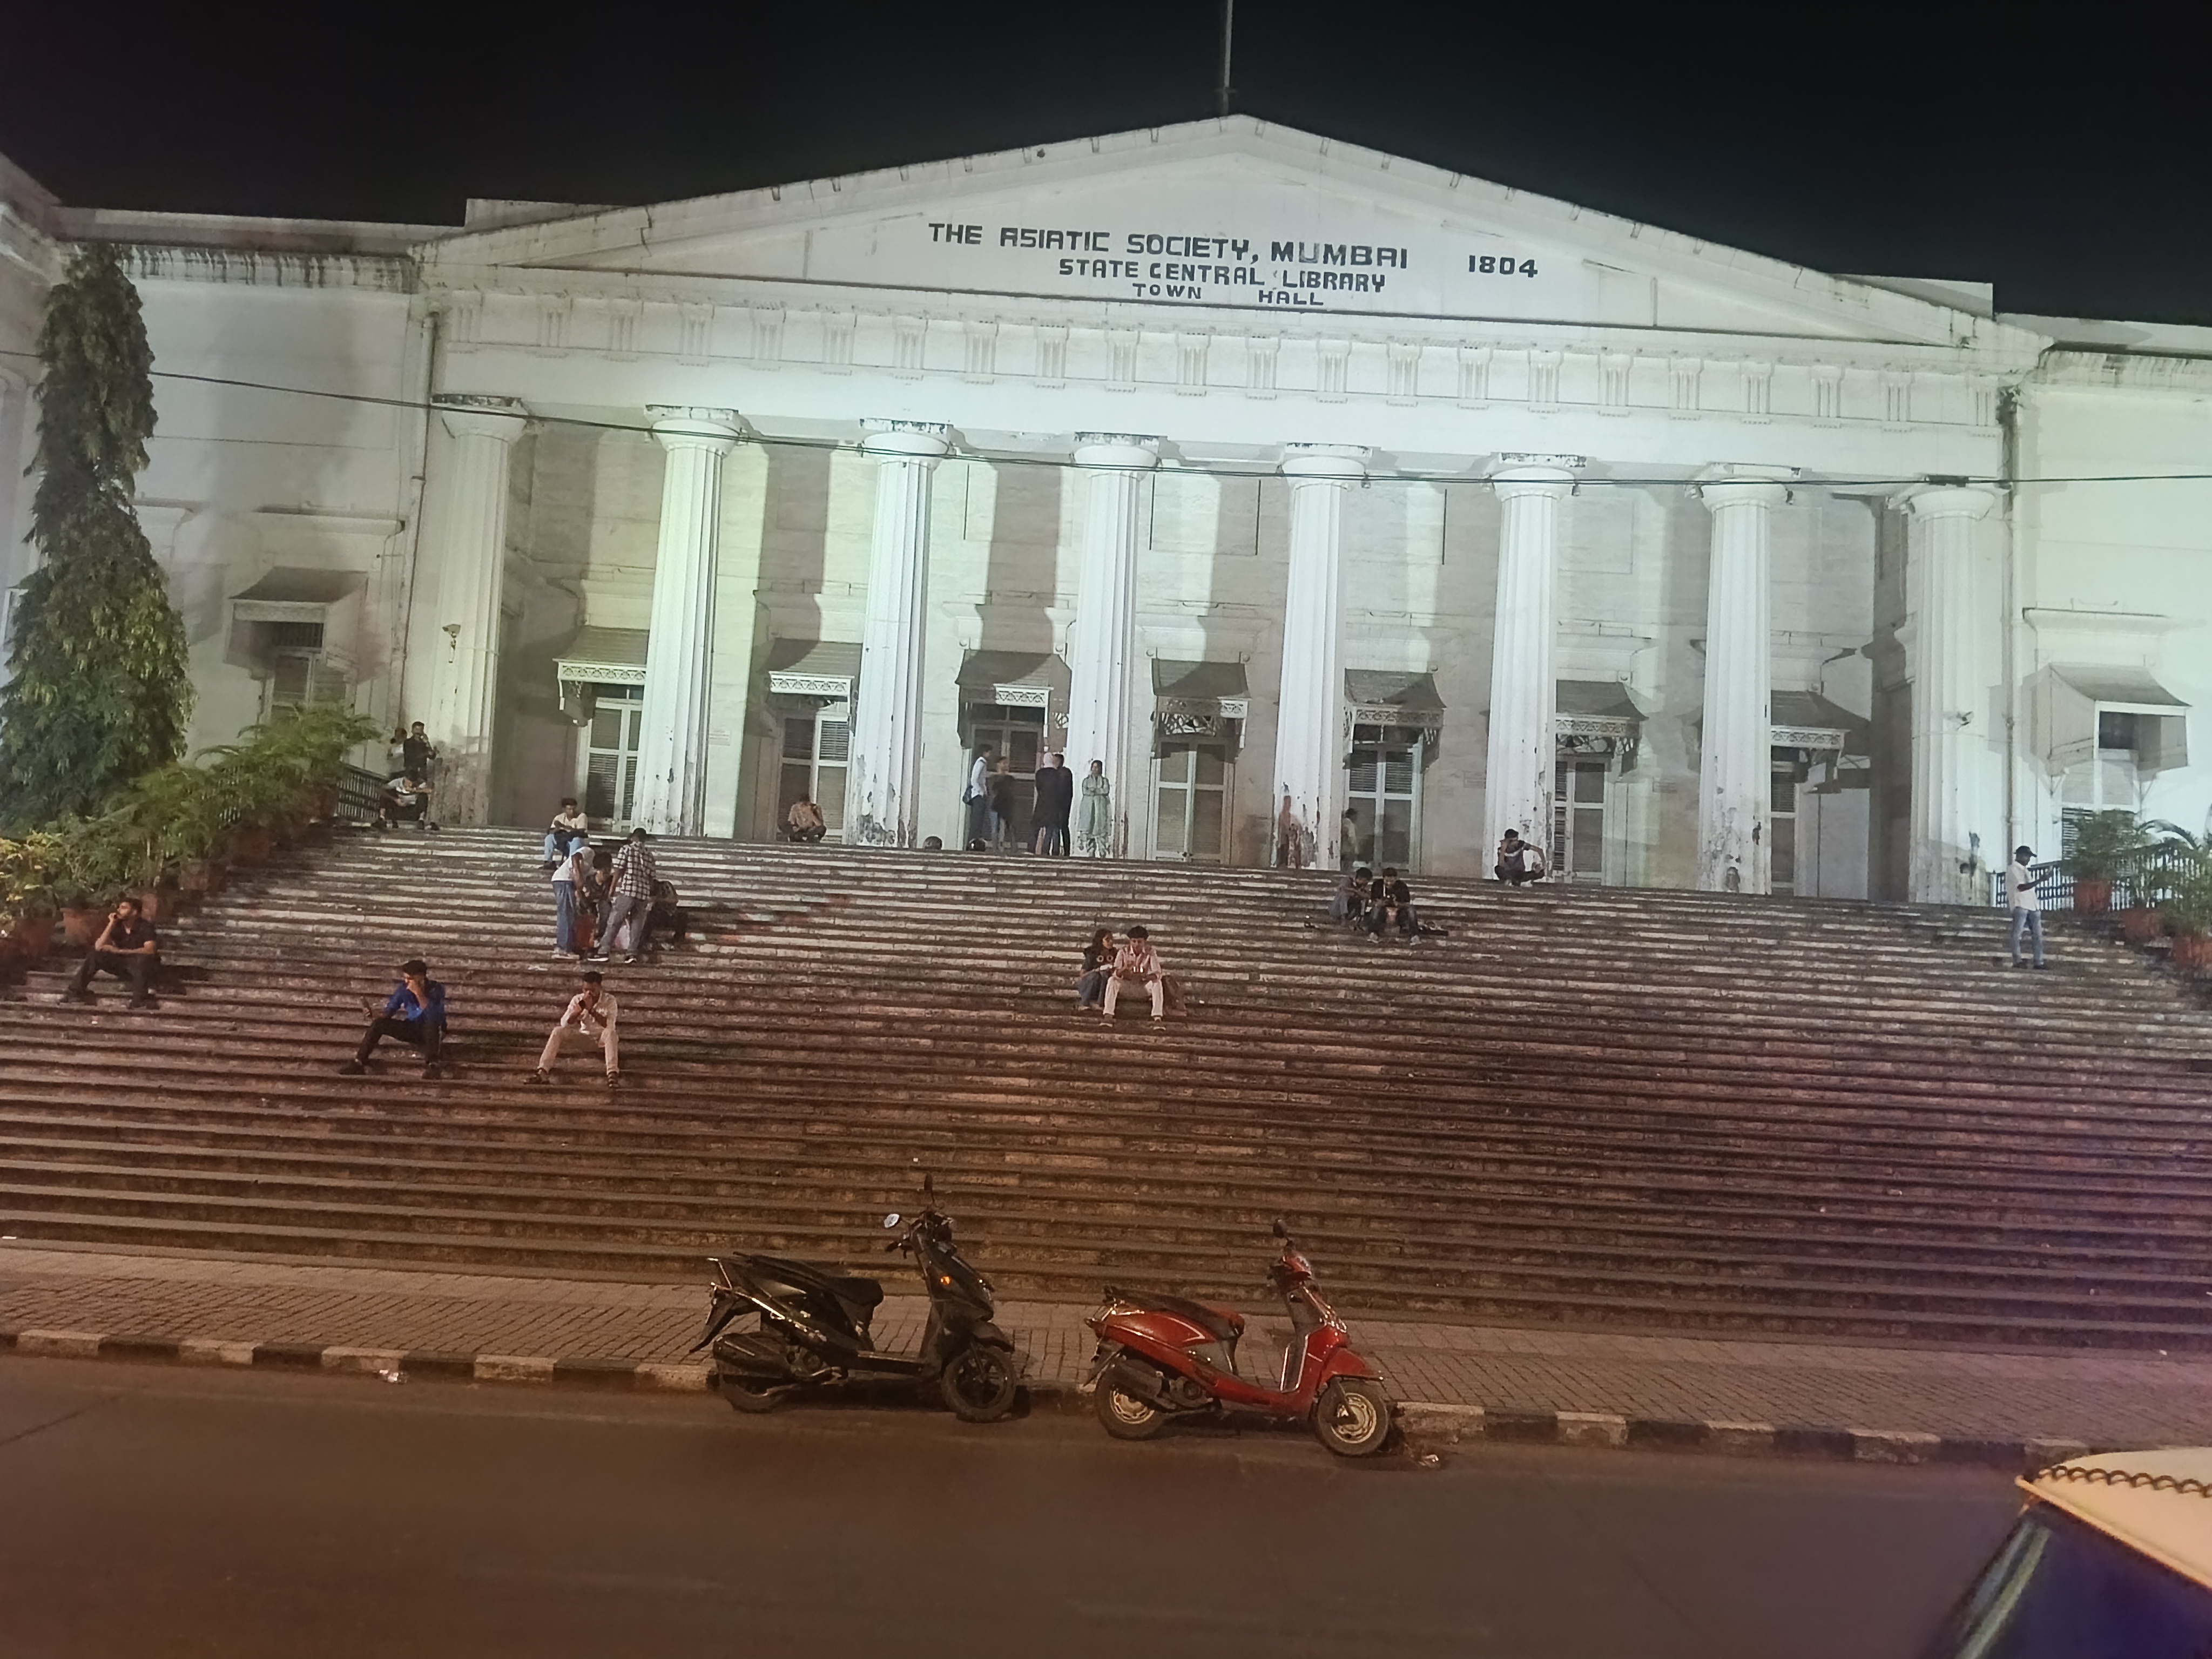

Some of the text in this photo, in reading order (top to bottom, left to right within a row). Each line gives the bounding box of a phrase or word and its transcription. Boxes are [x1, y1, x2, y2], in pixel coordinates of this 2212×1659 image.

[928, 223, 1407, 269] THE ASIATIC SOCIETY, MUMBAI
[1059, 259, 1386, 293] STATE CENTRAL LIBRARY
[1469, 255, 1538, 279] 1804
[1132, 283, 1324, 306] TOWN HALL
